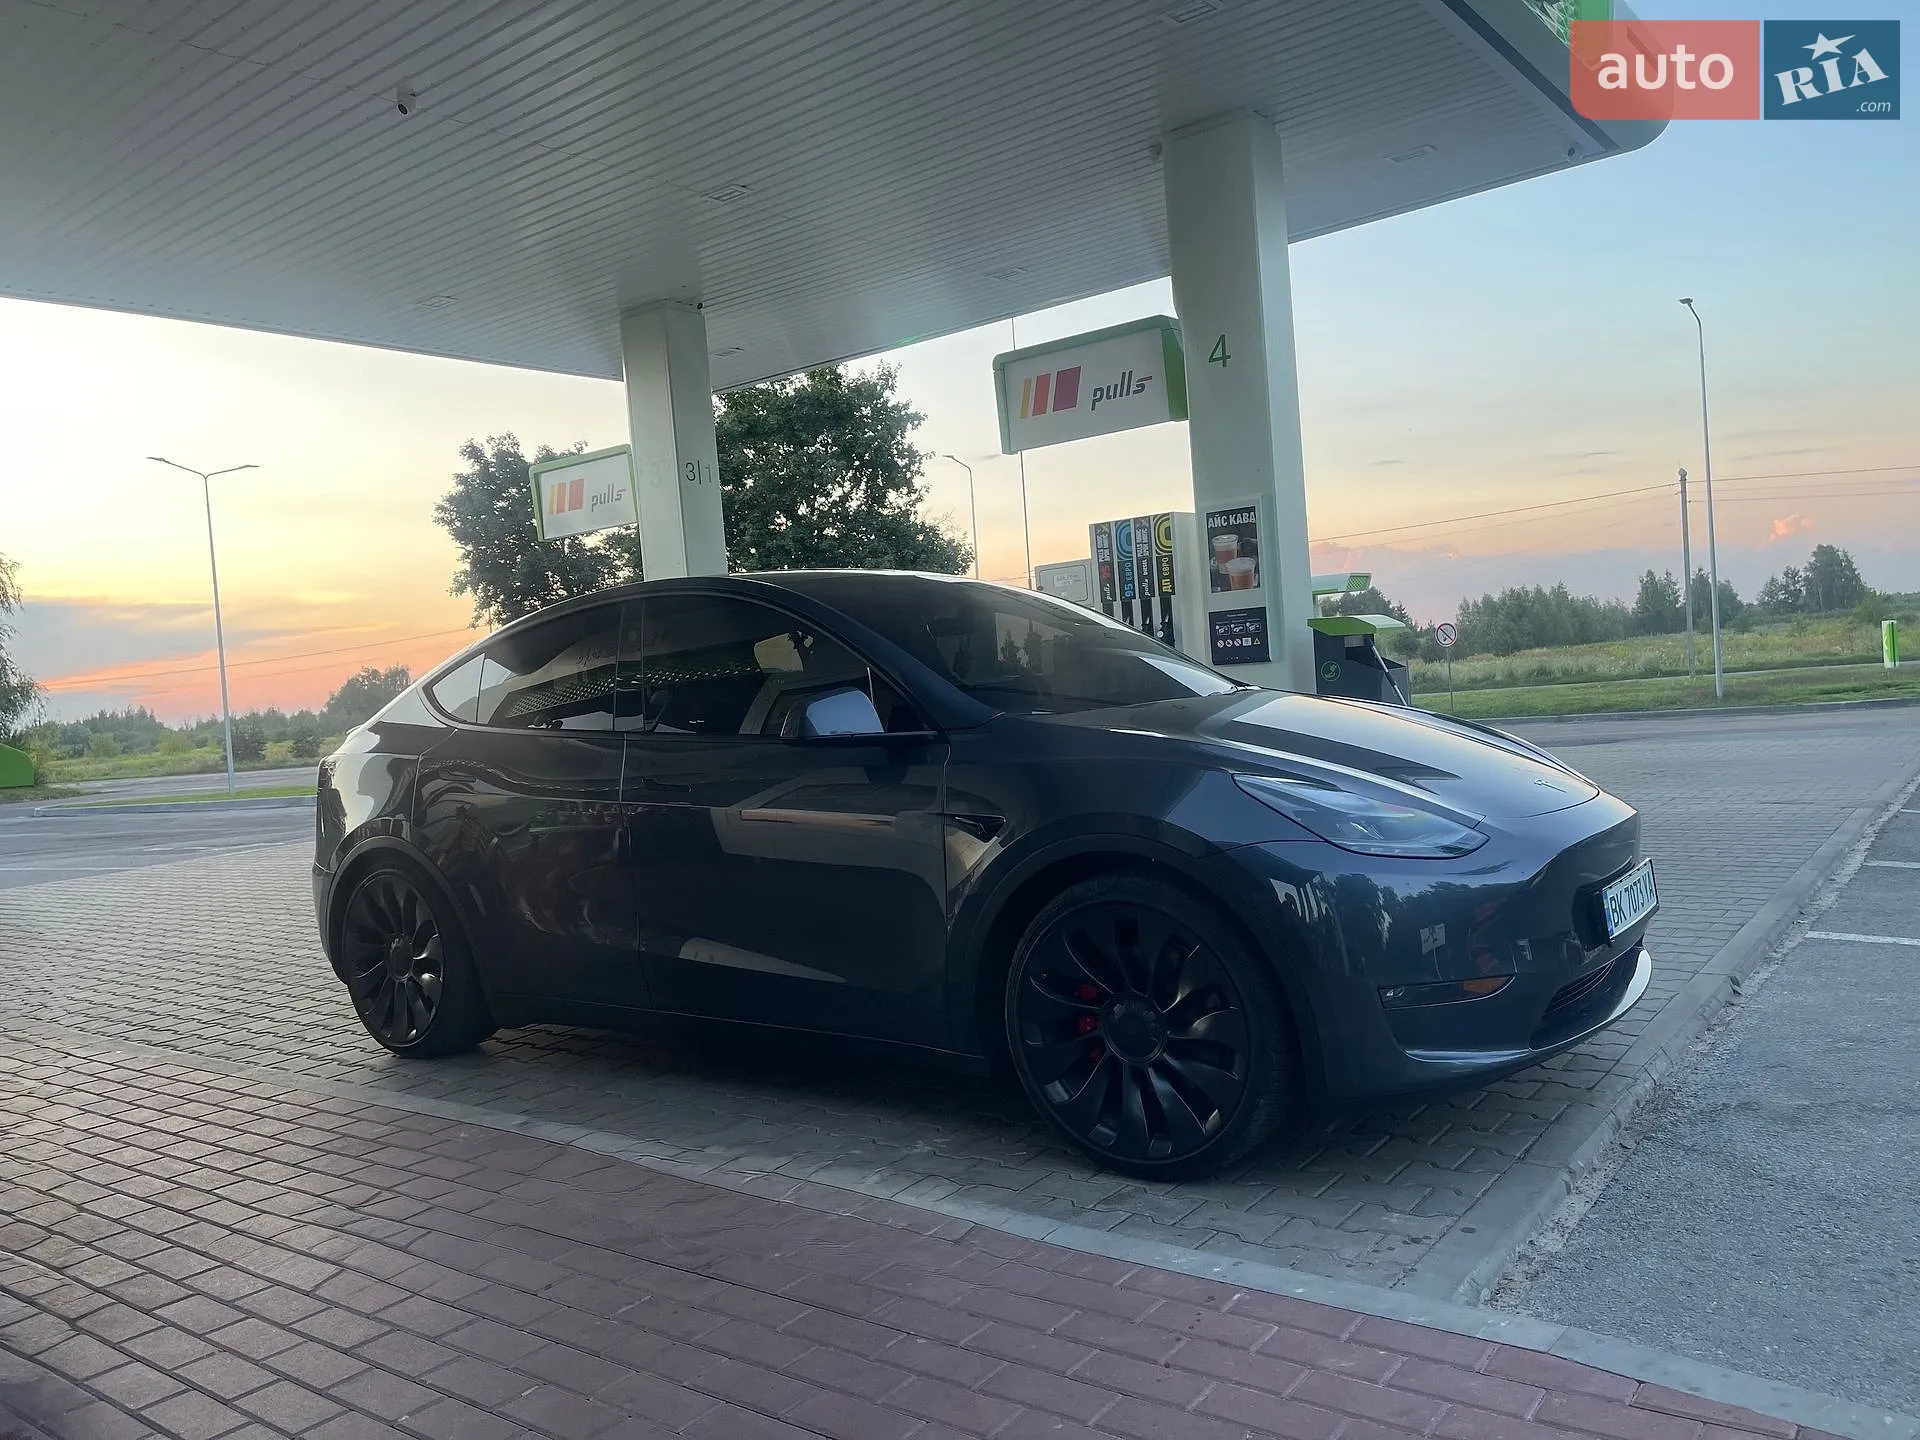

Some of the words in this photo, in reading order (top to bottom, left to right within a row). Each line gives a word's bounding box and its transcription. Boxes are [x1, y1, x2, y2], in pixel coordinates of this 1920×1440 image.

[1208, 334, 1231, 368] 4
[1091, 370, 1153, 411] pulls
[591, 483, 626, 513] pulls
[1208, 514, 1227, 529] АЙС
[1228, 511, 1256, 526] КАВА
[1124, 583, 1134, 598] 95
[1162, 579, 1173, 593] ДП
[1609, 890, 1627, 927] BK
[1624, 877, 1645, 917] 7073
